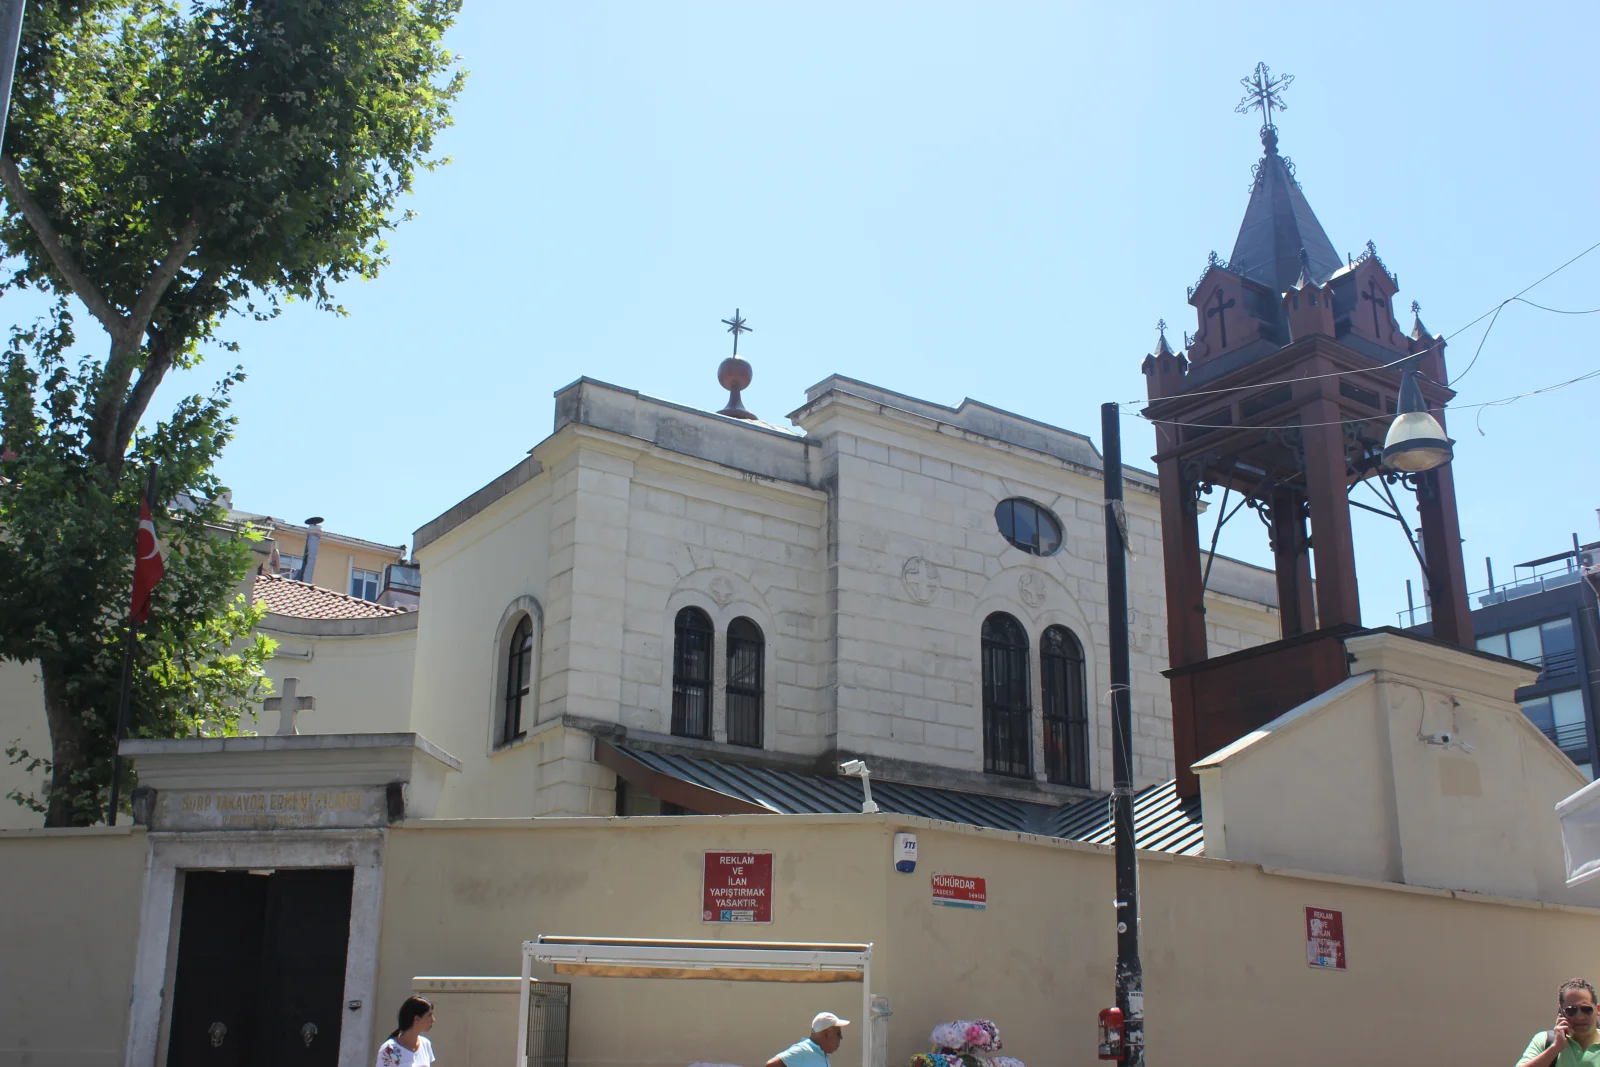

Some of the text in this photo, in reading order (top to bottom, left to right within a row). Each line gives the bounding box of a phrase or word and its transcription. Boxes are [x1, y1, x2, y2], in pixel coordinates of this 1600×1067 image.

[181, 795, 212, 811] SURP
[904, 841, 916, 849] STS
[720, 856, 754, 864] REKLAM
[732, 867, 743, 875] VE
[728, 876, 747, 885] İLAN
[933, 876, 975, 889] MÜHÜRDAR
[710, 888, 765, 898] YAPIŞTIRMAK
[715, 899, 759, 907] YASAKTIR.
[1314, 911, 1333, 919] REKLAM
